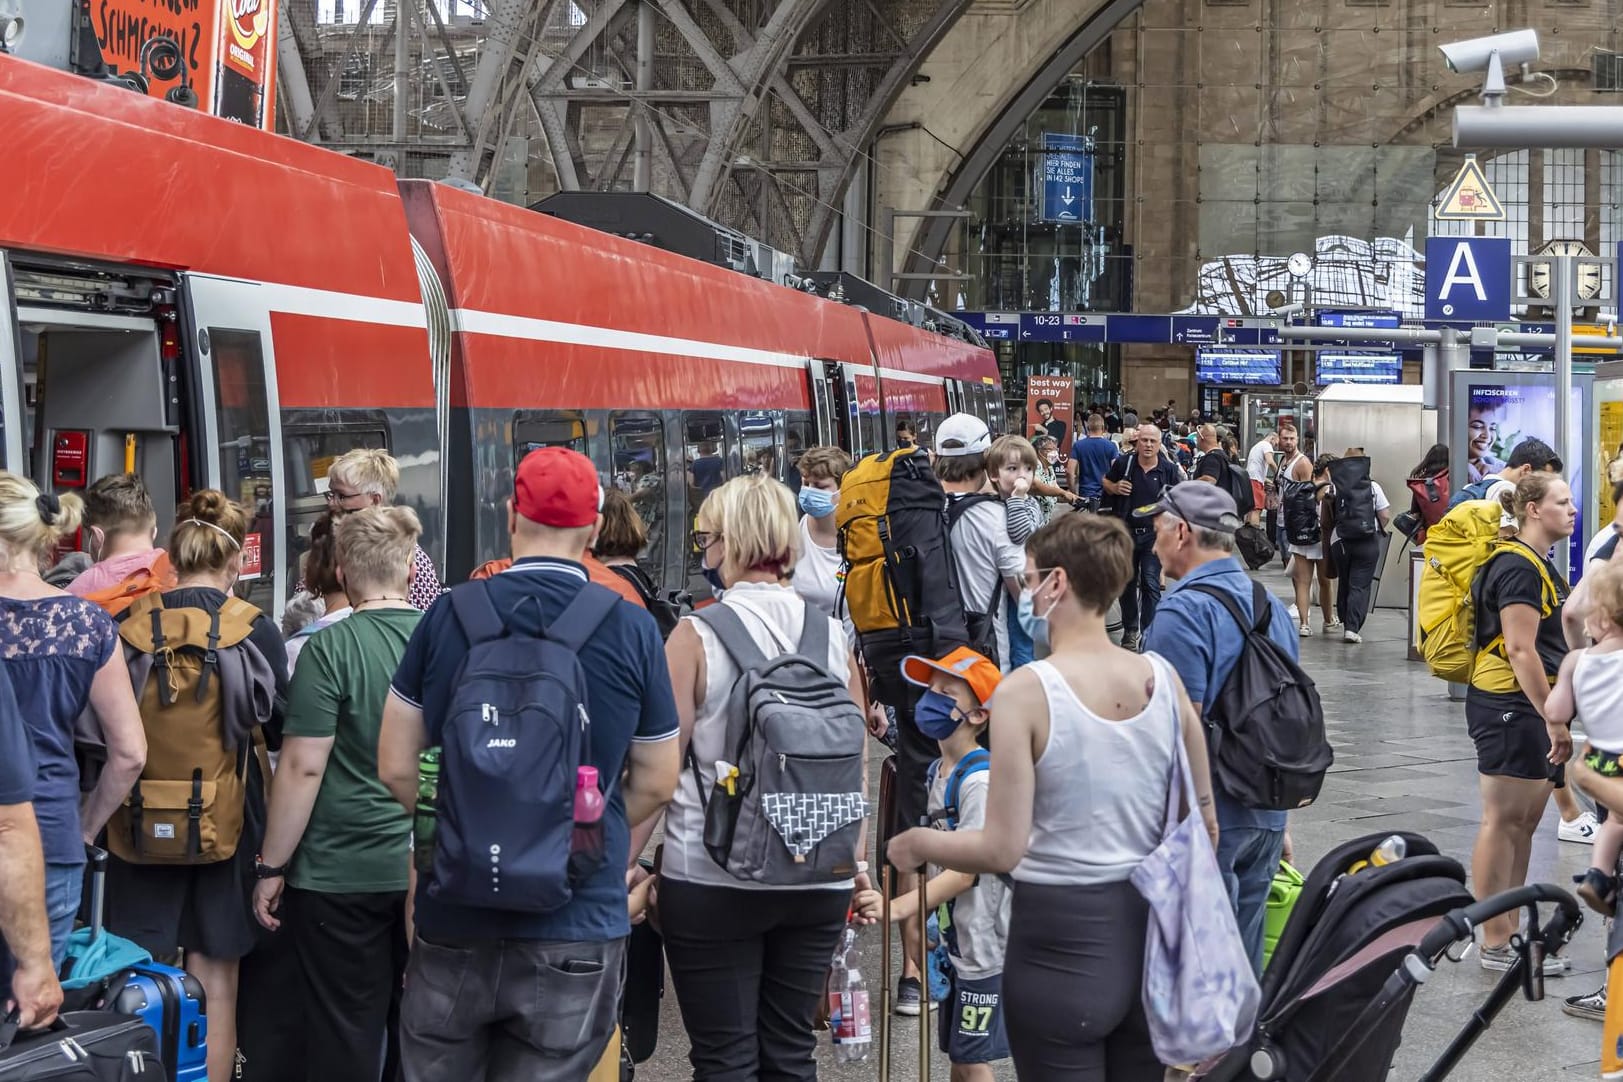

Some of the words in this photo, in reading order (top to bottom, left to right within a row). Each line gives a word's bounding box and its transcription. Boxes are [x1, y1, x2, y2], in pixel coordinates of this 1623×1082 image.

[1046, 159, 1060, 167] HIER
[1060, 160, 1081, 168] FINDEN
[1438, 242, 1488, 300] A
[1034, 315, 1060, 326] 10-23
[1030, 378, 1050, 387] best
[1052, 380, 1071, 389] way
[1030, 388, 1040, 396] to
[1041, 388, 1061, 398] stay
[487, 738, 517, 748] JAKO
[960, 991, 999, 1005] STRONG
[960, 1005, 993, 1031] 97
